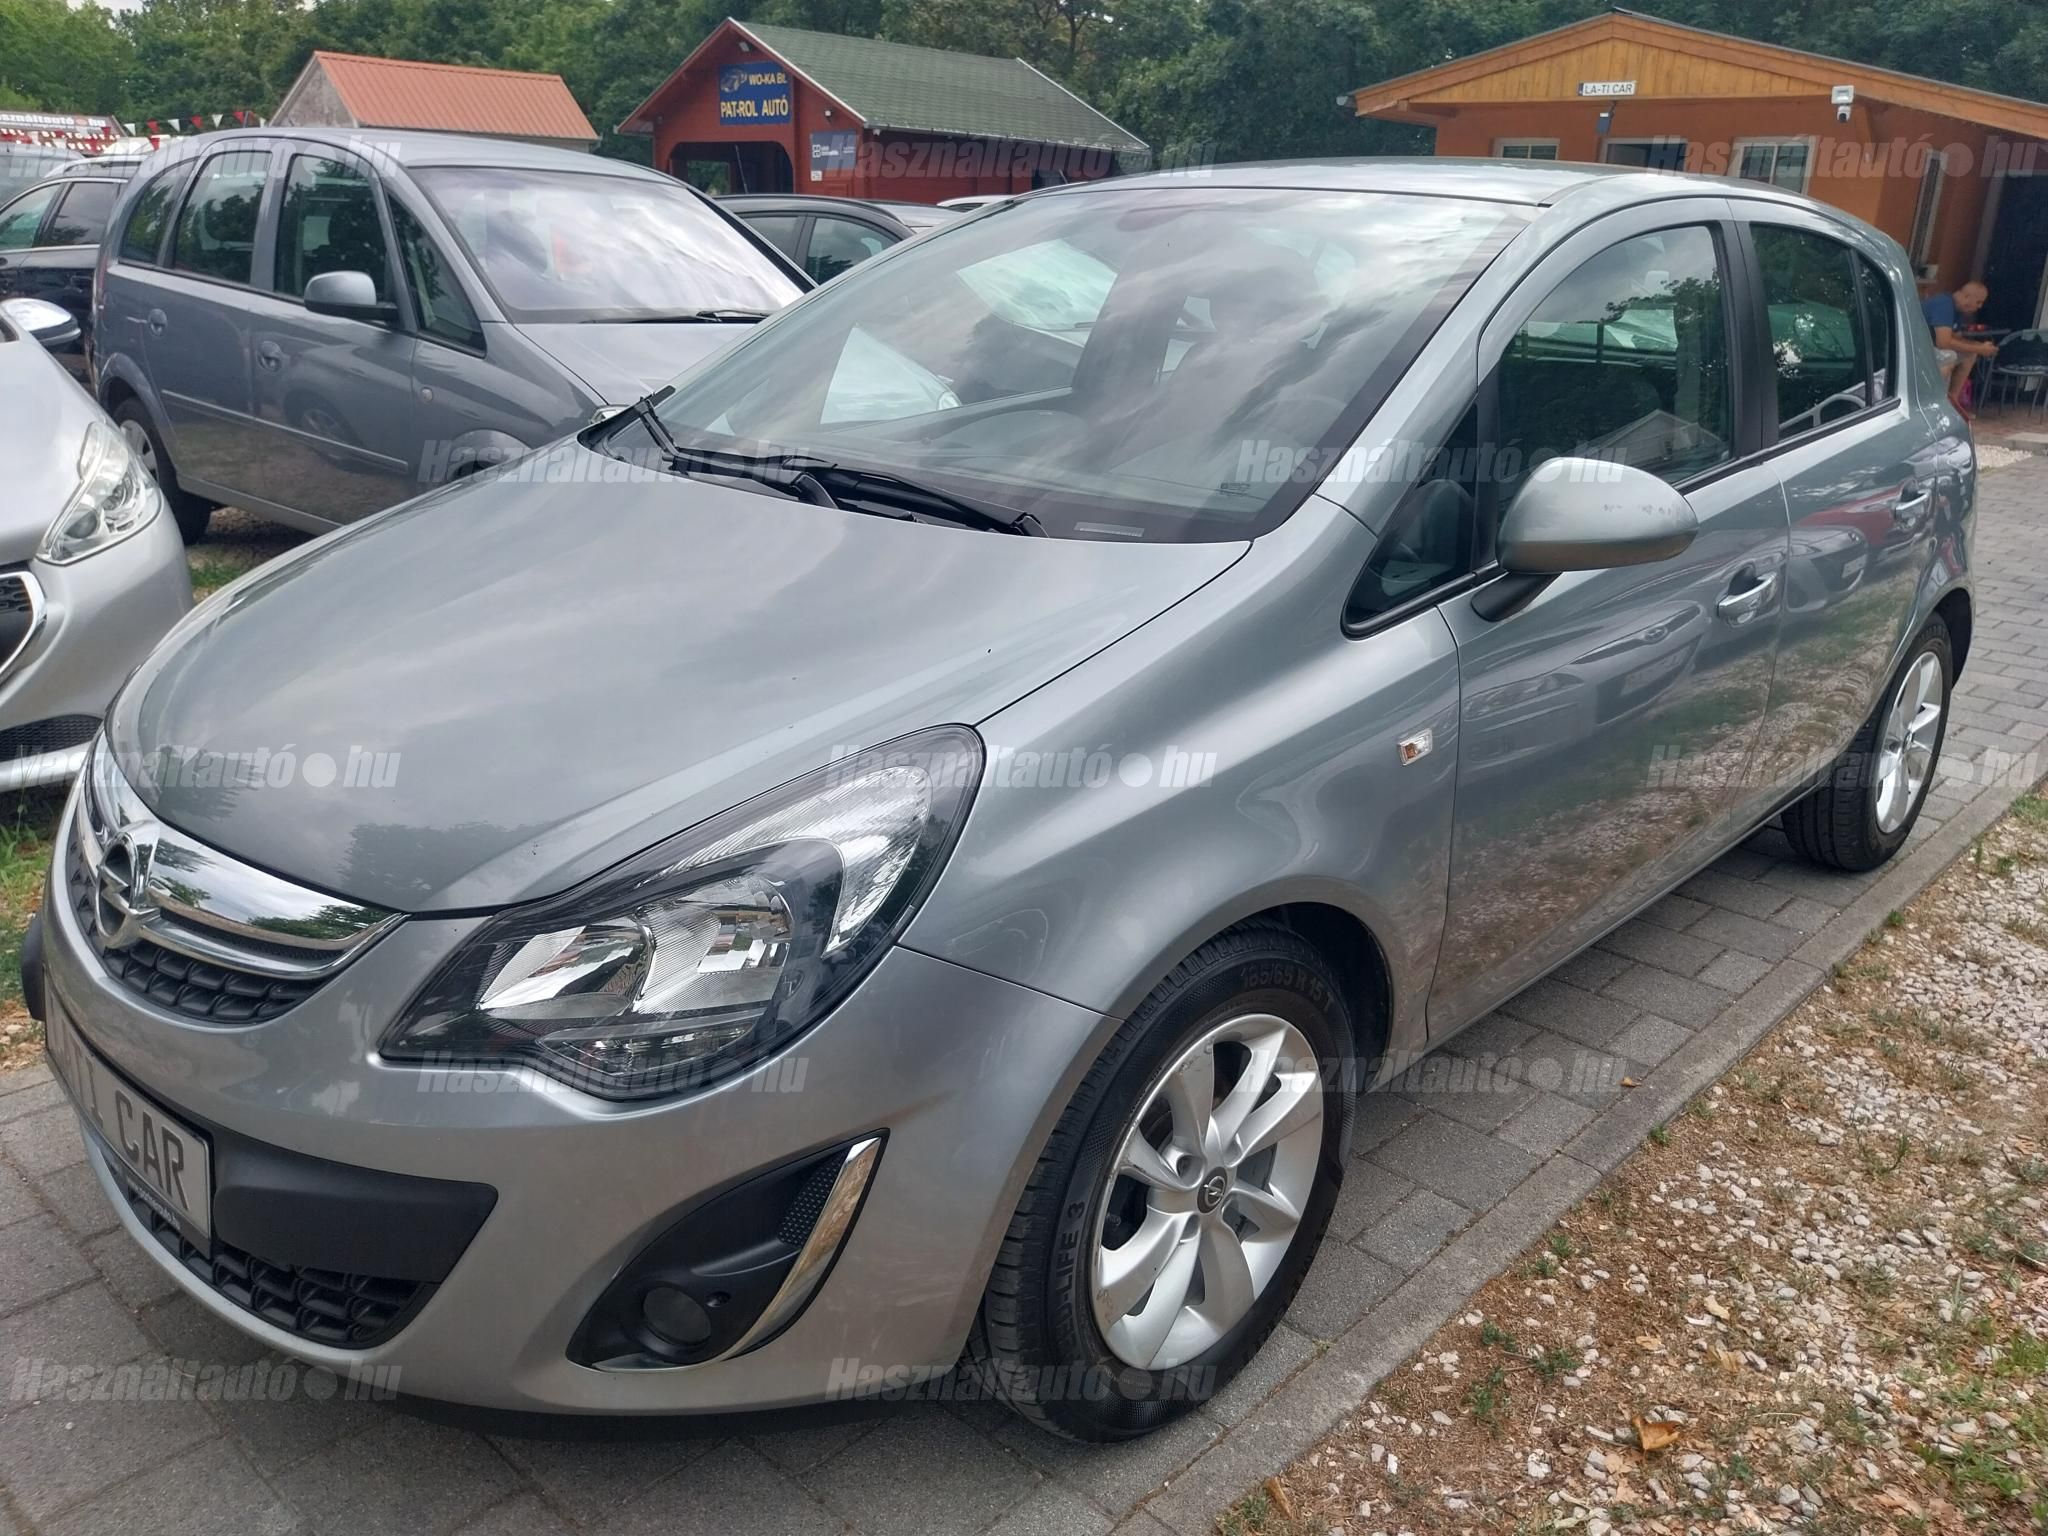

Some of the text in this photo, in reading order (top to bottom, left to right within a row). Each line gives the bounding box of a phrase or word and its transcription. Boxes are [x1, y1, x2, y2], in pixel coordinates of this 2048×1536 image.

[1585, 83, 1633, 94] LA-TI CAR
[721, 95, 789, 118] PAT-ROL AUTÓ
[115, 1089, 189, 1211] CAR
[1067, 1201, 1086, 1219] 3
